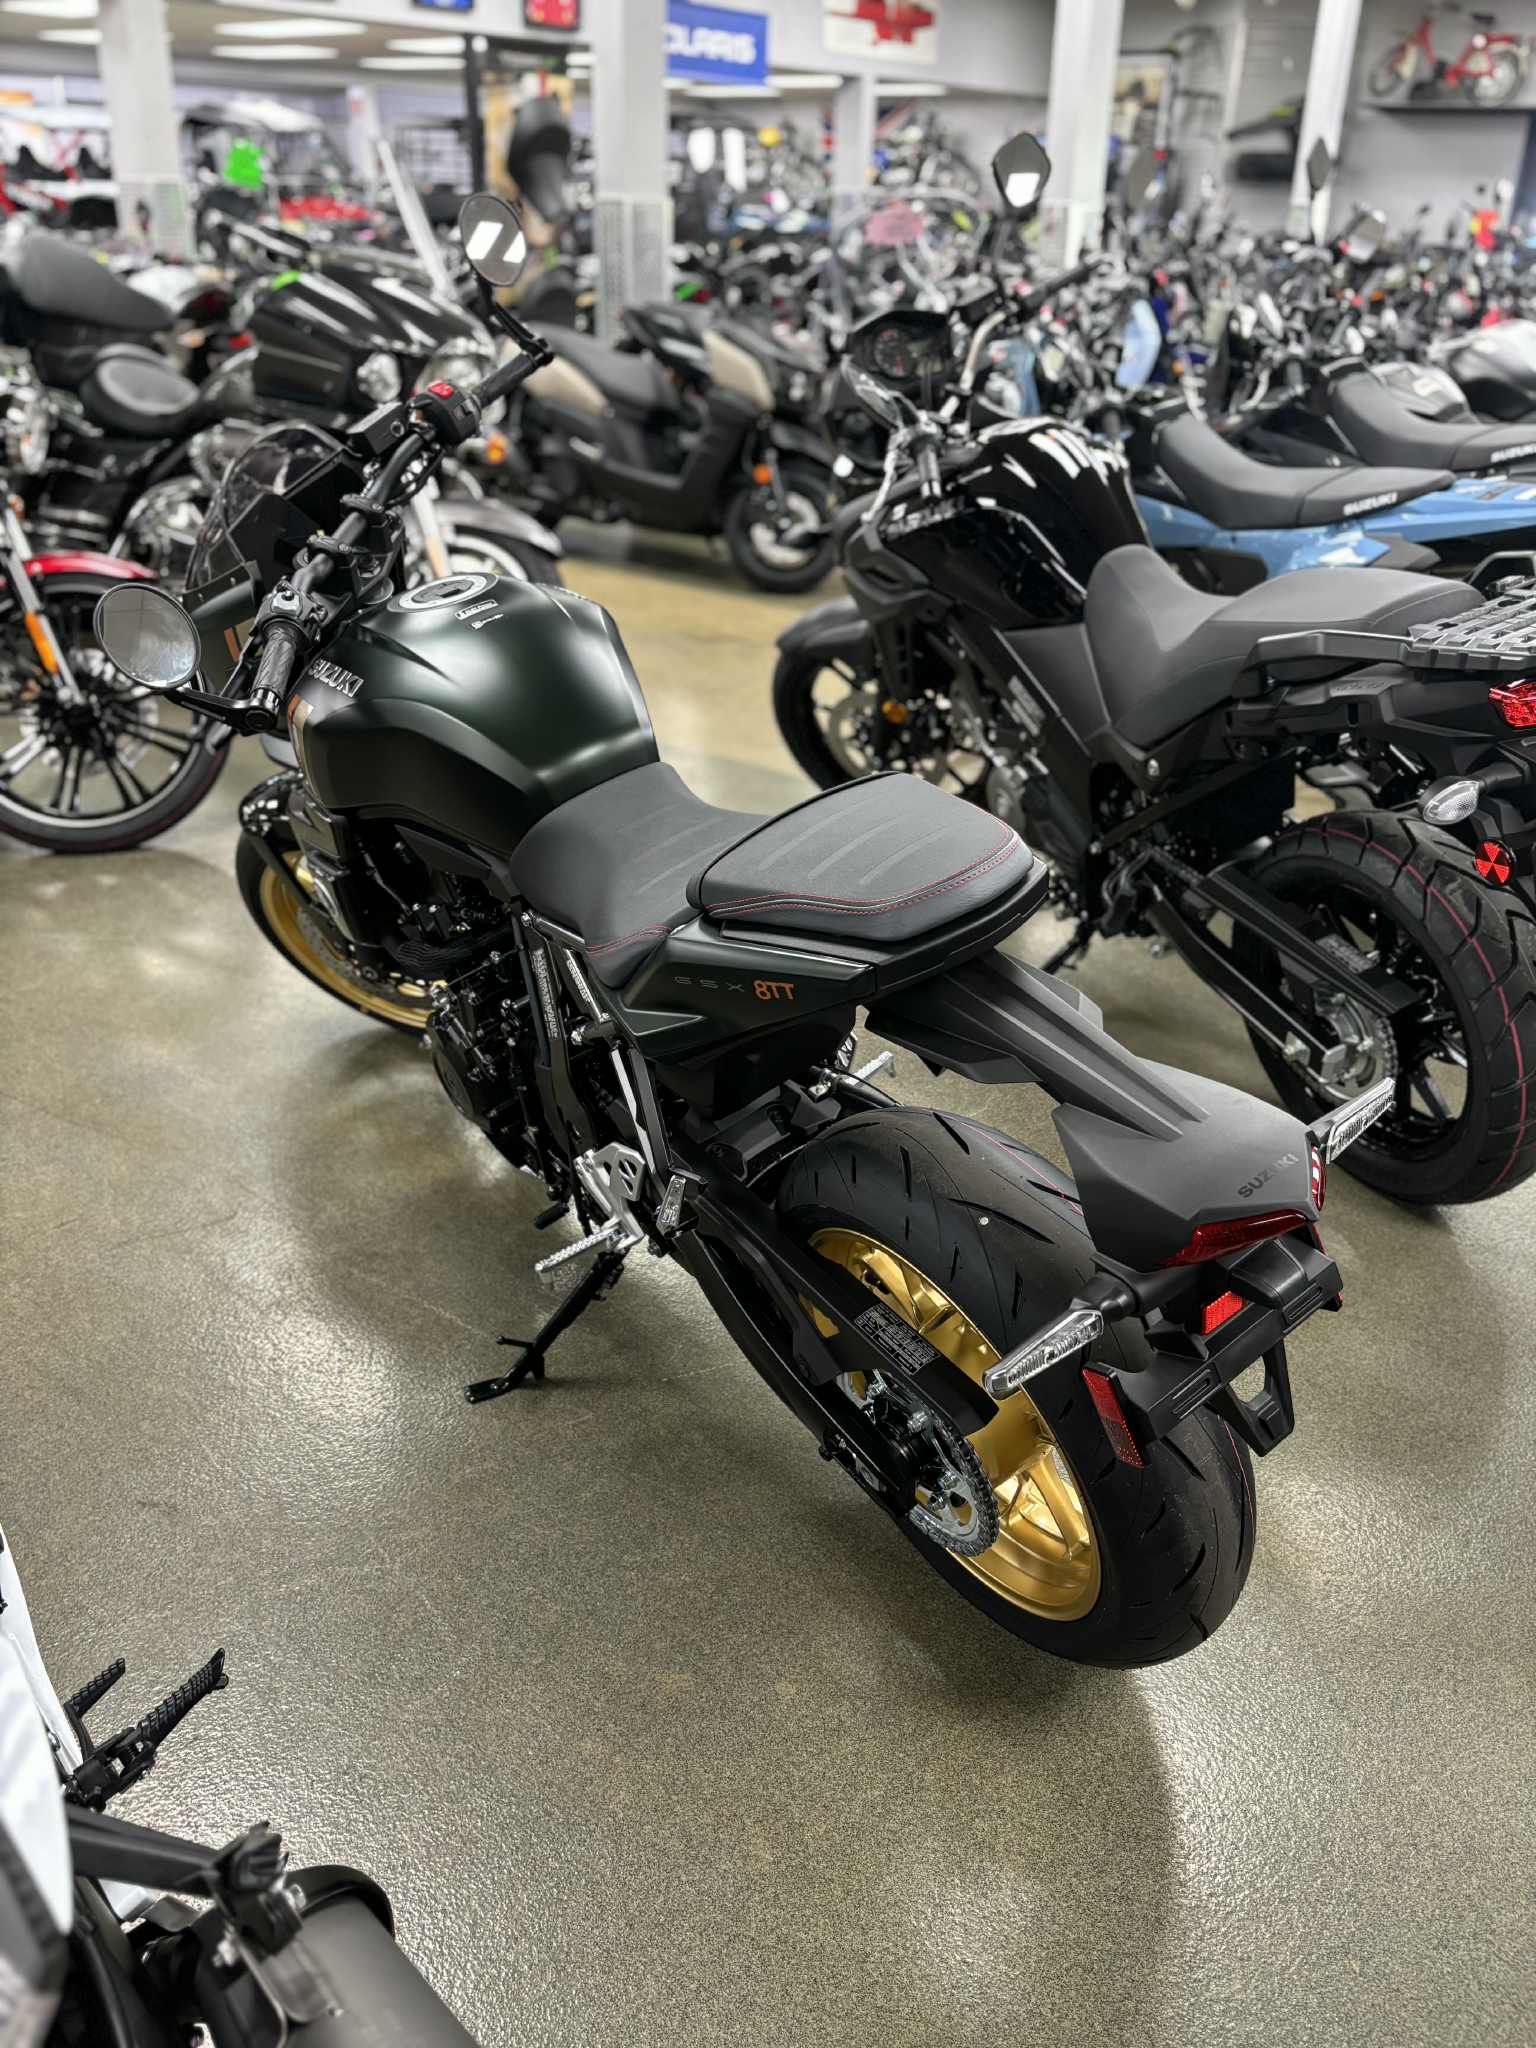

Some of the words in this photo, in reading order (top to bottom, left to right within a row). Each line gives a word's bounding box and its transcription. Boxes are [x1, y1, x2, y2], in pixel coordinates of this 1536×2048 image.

[664, 22, 757, 64] OLARIS
[1343, 491, 1398, 516] SUZUKI
[308, 659, 364, 698] SUZUKI
[753, 979, 796, 1001] 8TT
[1237, 1152, 1300, 1199] SUZUKI
